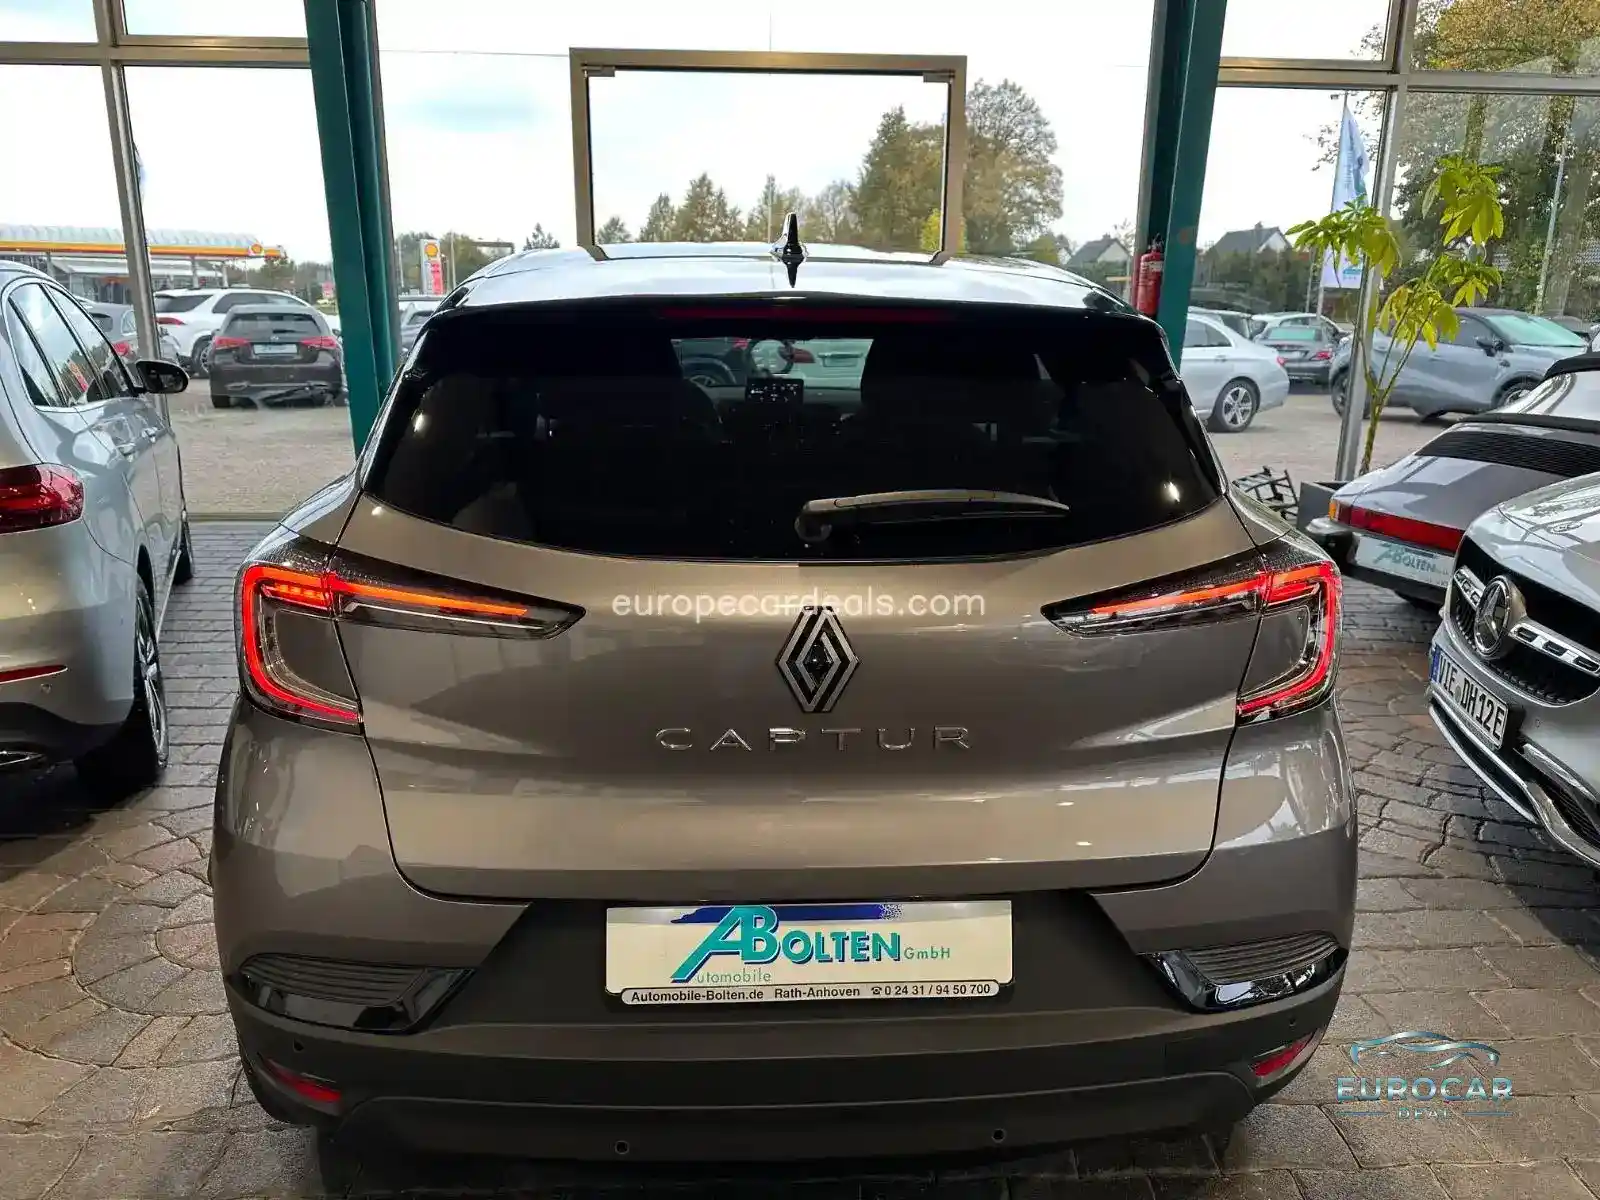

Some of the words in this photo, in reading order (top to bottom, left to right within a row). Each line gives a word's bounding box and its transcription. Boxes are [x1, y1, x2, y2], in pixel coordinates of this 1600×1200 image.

[655, 726, 973, 752] CAPTUR
[904, 947, 950, 960] GmbH
[632, 990, 764, 1002] Automobile-Bolten.de
[774, 986, 860, 998] Rath-Anhoven
